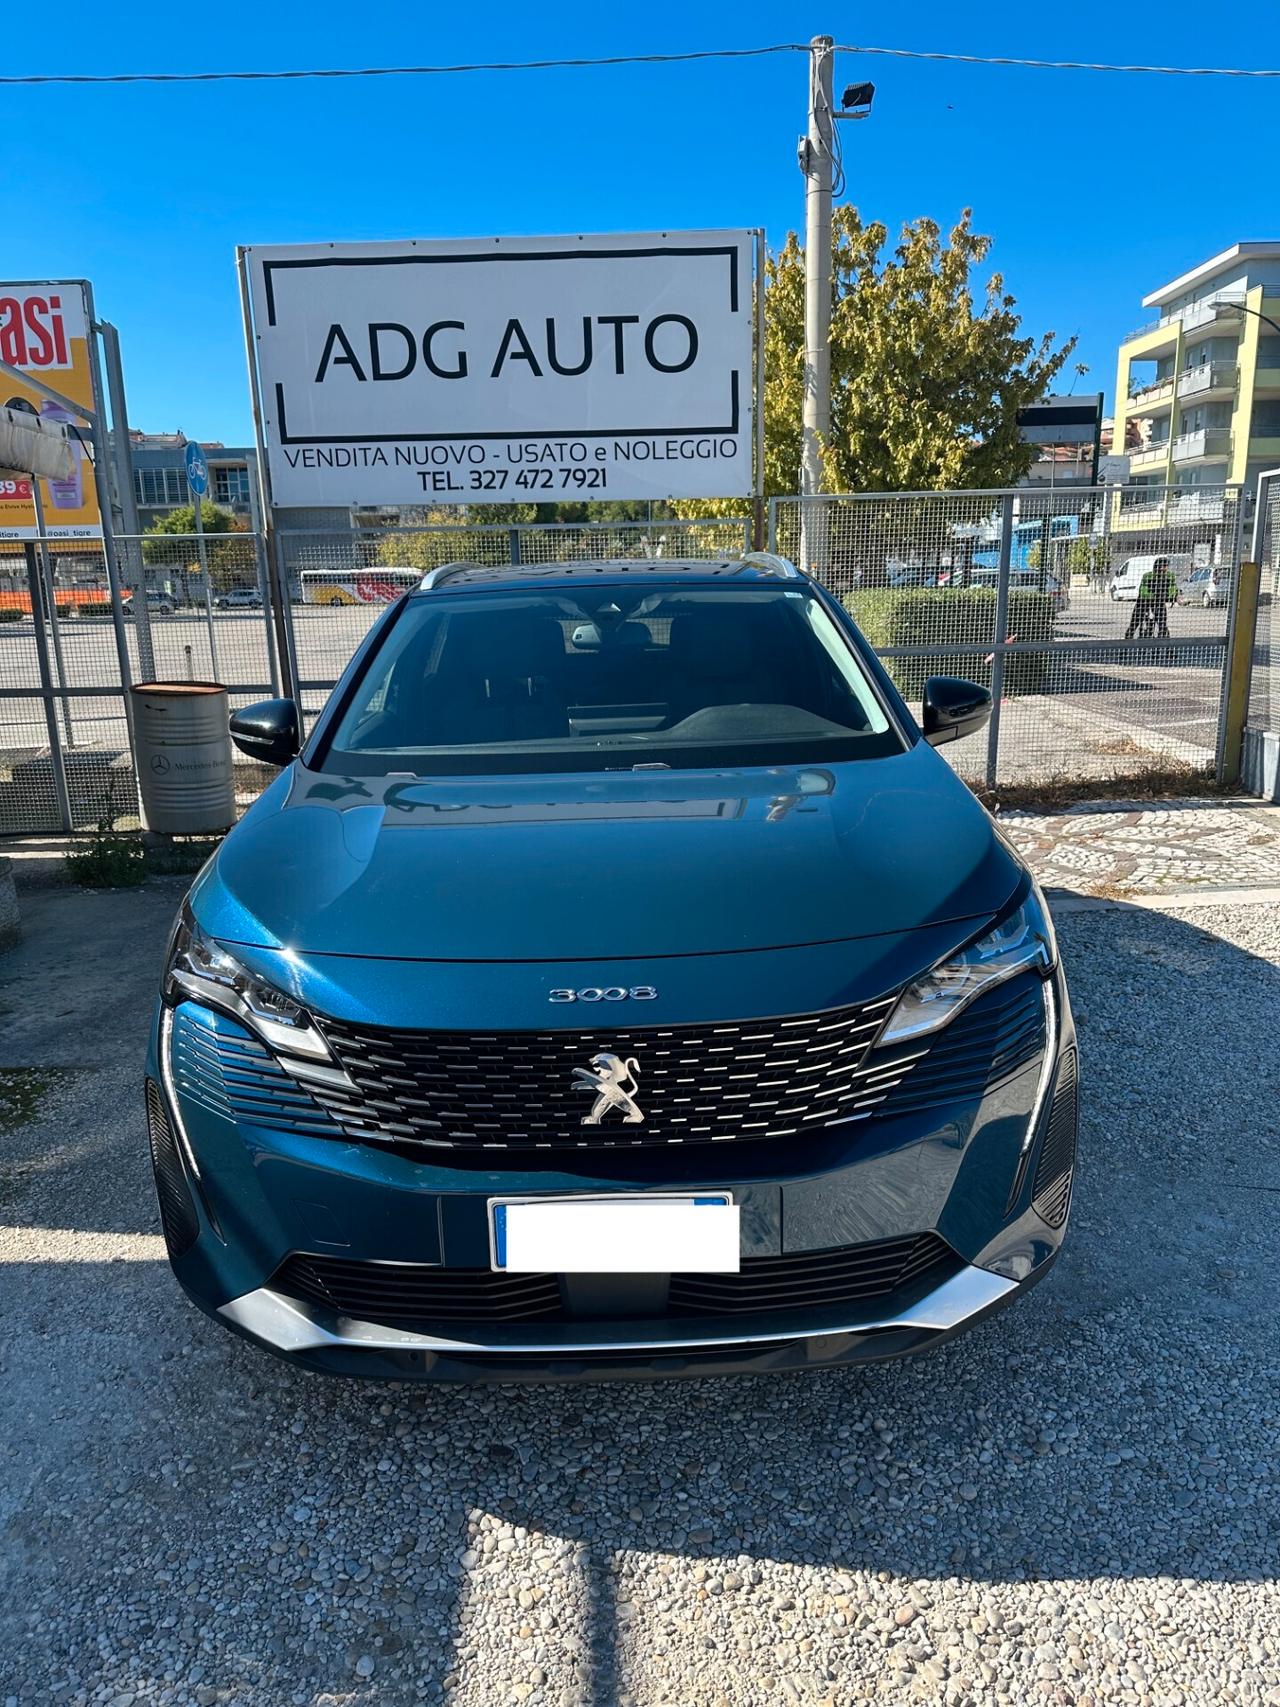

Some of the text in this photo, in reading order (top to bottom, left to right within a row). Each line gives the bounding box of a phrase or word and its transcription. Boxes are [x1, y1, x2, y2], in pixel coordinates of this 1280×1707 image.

[314, 313, 699, 383] ADG AUTO
[283, 446, 389, 468] VENDITA
[394, 444, 486, 466] NUOVO
[507, 442, 587, 464] USATO
[594, 446, 607, 462] e
[613, 438, 738, 461] NOLEGGIO
[417, 467, 607, 491] TEL. 327 472 7921
[548, 985, 659, 1003] 3008
